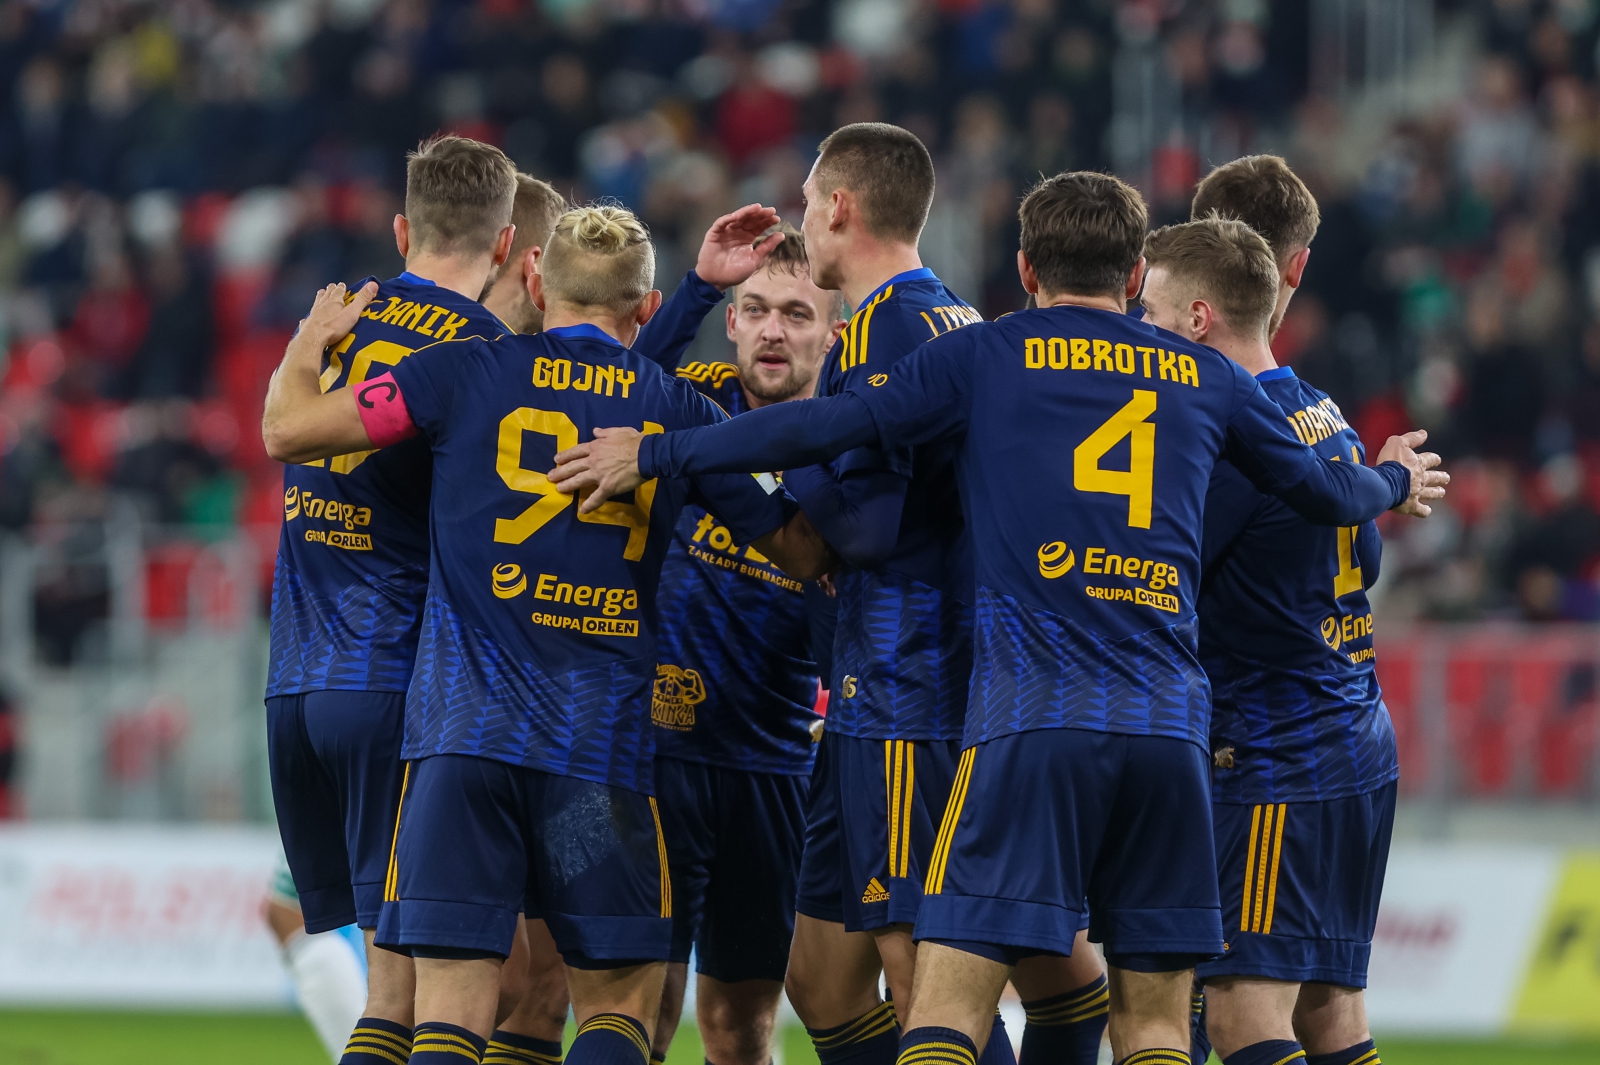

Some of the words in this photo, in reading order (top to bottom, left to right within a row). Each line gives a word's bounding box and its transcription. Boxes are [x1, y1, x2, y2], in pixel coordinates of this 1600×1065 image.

[532, 356, 636, 398] GOJNY
[1024, 337, 1199, 387] DOBROTKA
[358, 381, 397, 408] C
[1073, 389, 1157, 529] 4
[494, 406, 664, 562] 94
[302, 491, 371, 530] Energa
[330, 534, 370, 548] ORLEN
[688, 545, 738, 570] ZAKŁADY
[740, 564, 804, 593] BUKMACHER
[1083, 547, 1179, 590] Energa
[533, 573, 638, 616] Energa
[1085, 586, 1134, 602] GRUPA
[1137, 589, 1177, 611] ORLEN
[531, 612, 581, 631] GRUPA
[585, 618, 636, 635] ORLEN
[1341, 612, 1374, 642] Ene
[651, 699, 695, 725] KINGA
[862, 891, 890, 903] adidas
